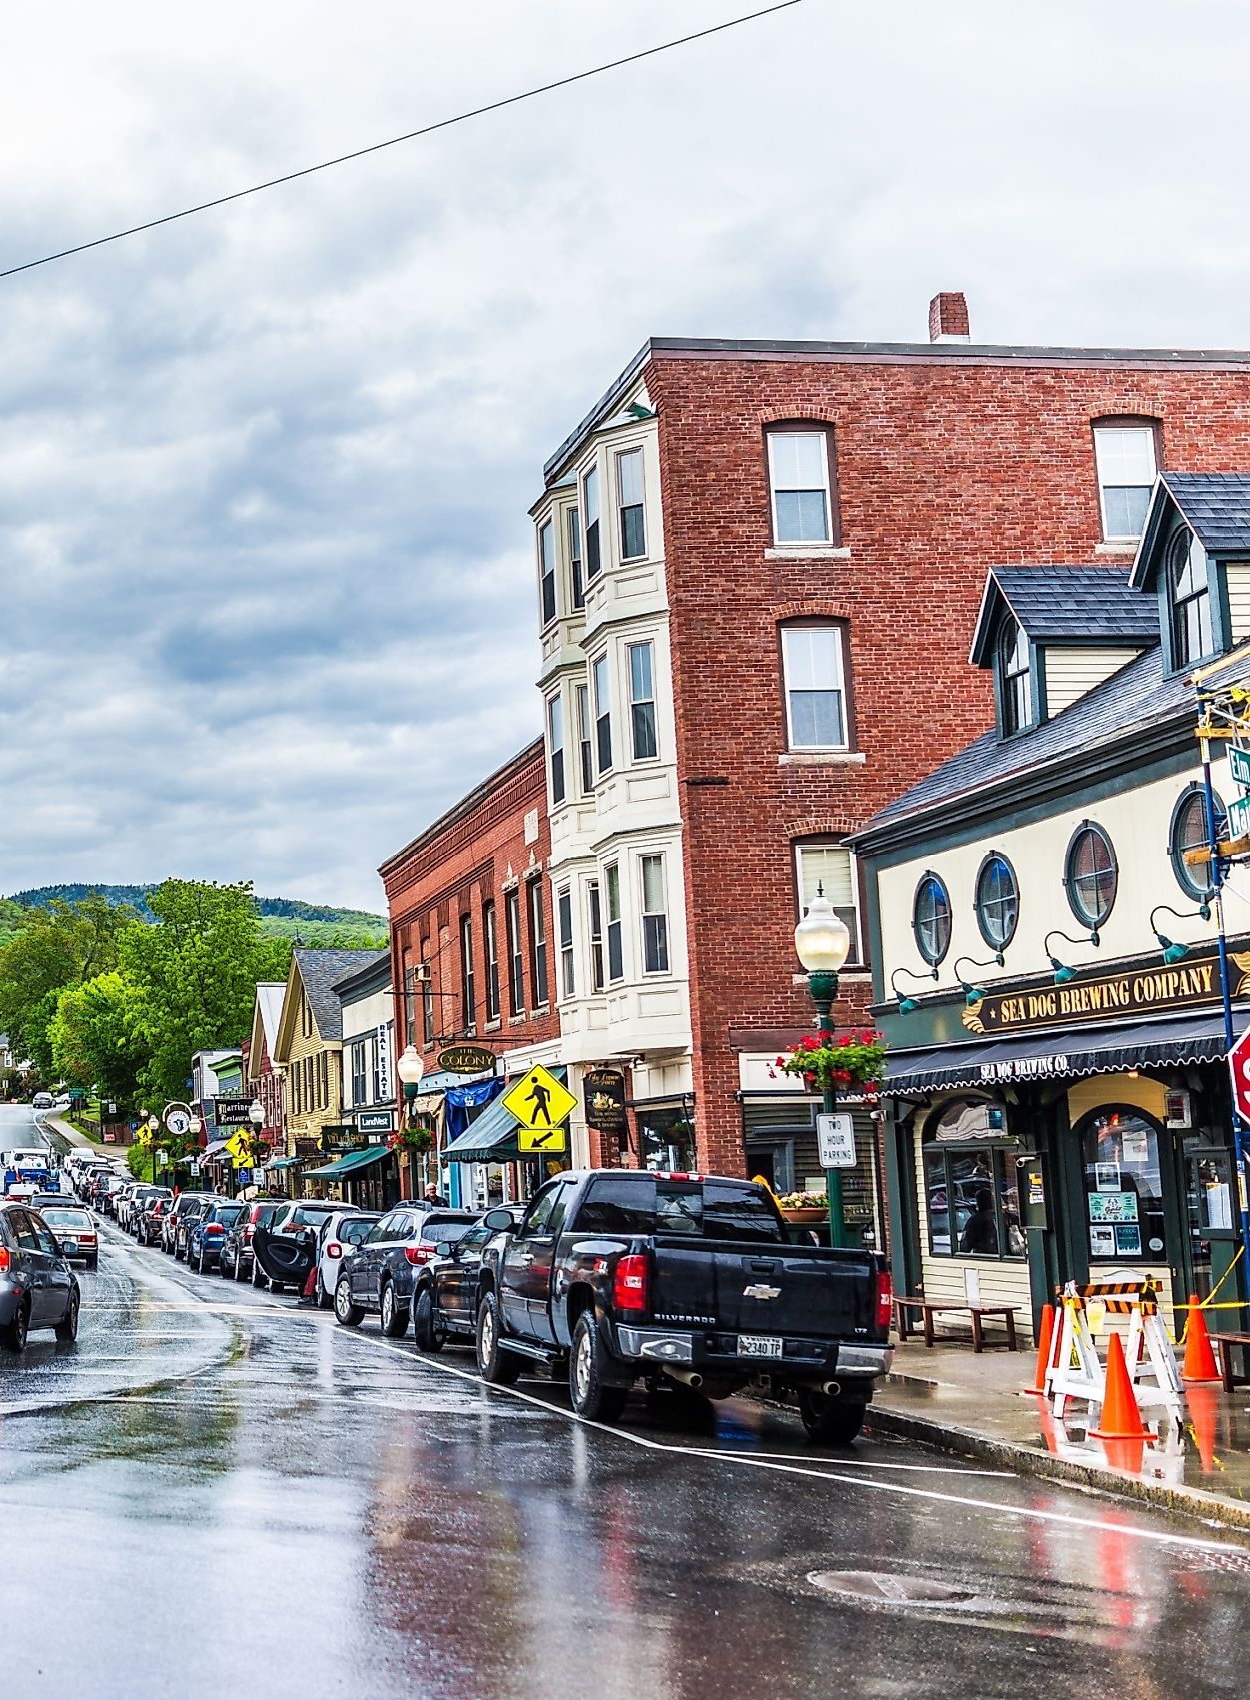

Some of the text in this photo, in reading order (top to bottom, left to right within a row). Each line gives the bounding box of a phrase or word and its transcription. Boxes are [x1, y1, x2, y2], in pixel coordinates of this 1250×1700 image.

[1000, 965, 1213, 1023] SEA DOG BREWING COMPANY
[379, 1024, 388, 1096] REAL ESTATE
[440, 1055, 493, 1066] COLONY
[980, 1065, 996, 1080] SEA
[218, 1102, 251, 1114] Marrine
[362, 1117, 388, 1126] LandVest
[827, 1120, 842, 1130] TWO
[826, 1135, 845, 1145] HOUR
[823, 1150, 852, 1160] PARKING
[654, 1313, 716, 1324] SILVERADO
[747, 1342, 781, 1355] 2340 TP
